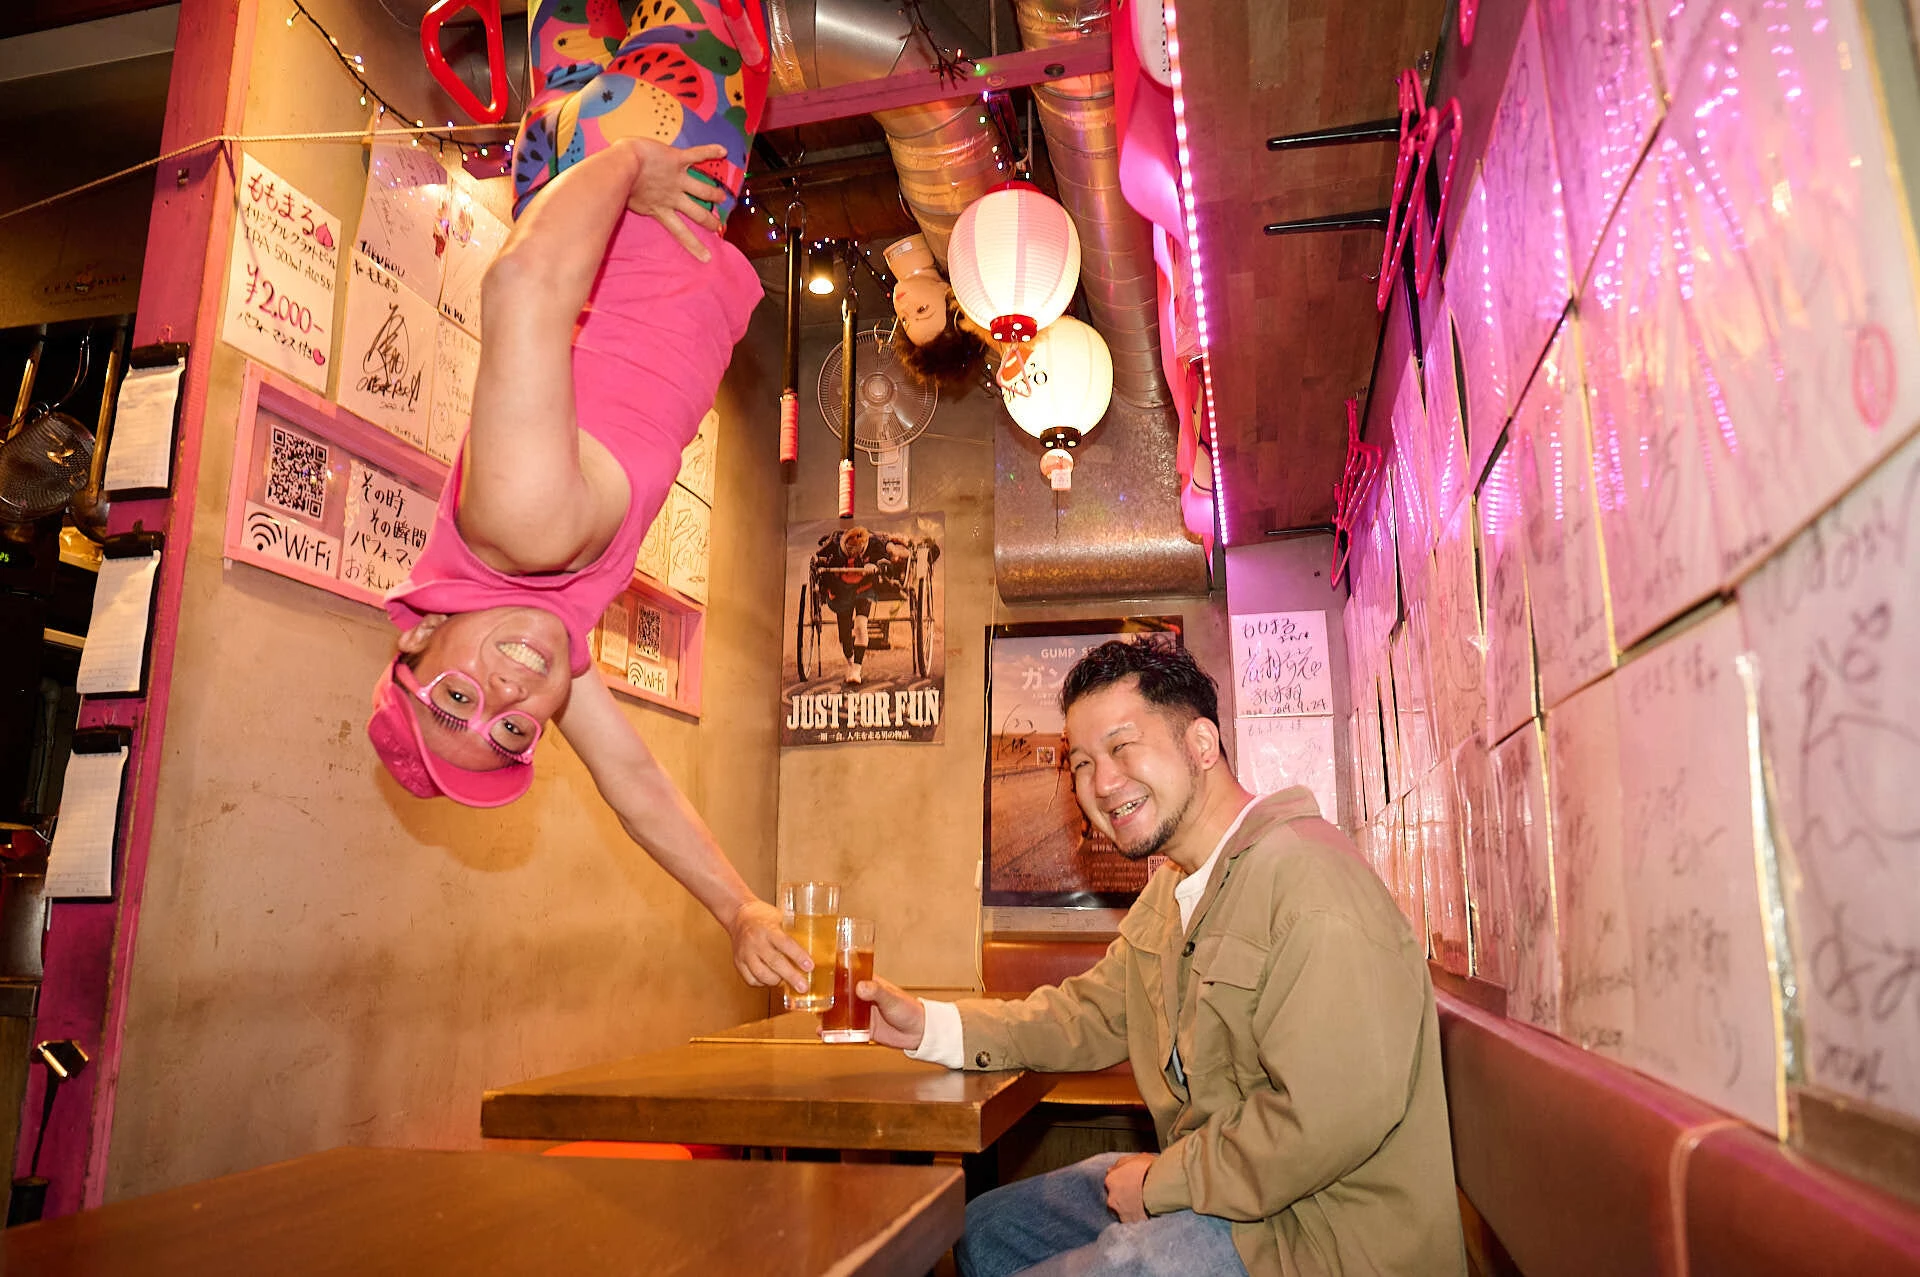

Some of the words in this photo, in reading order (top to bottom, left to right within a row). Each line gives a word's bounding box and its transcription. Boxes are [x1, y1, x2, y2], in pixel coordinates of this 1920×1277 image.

[247, 173, 314, 236] ももまる
[245, 223, 269, 254] IPA
[361, 471, 404, 517] その時
[370, 508, 427, 549] その瞬間
[1040, 648, 1075, 659] GUMP
[786, 694, 843, 731] JUST
[848, 692, 891, 728] FOR
[895, 689, 940, 728] FUN
